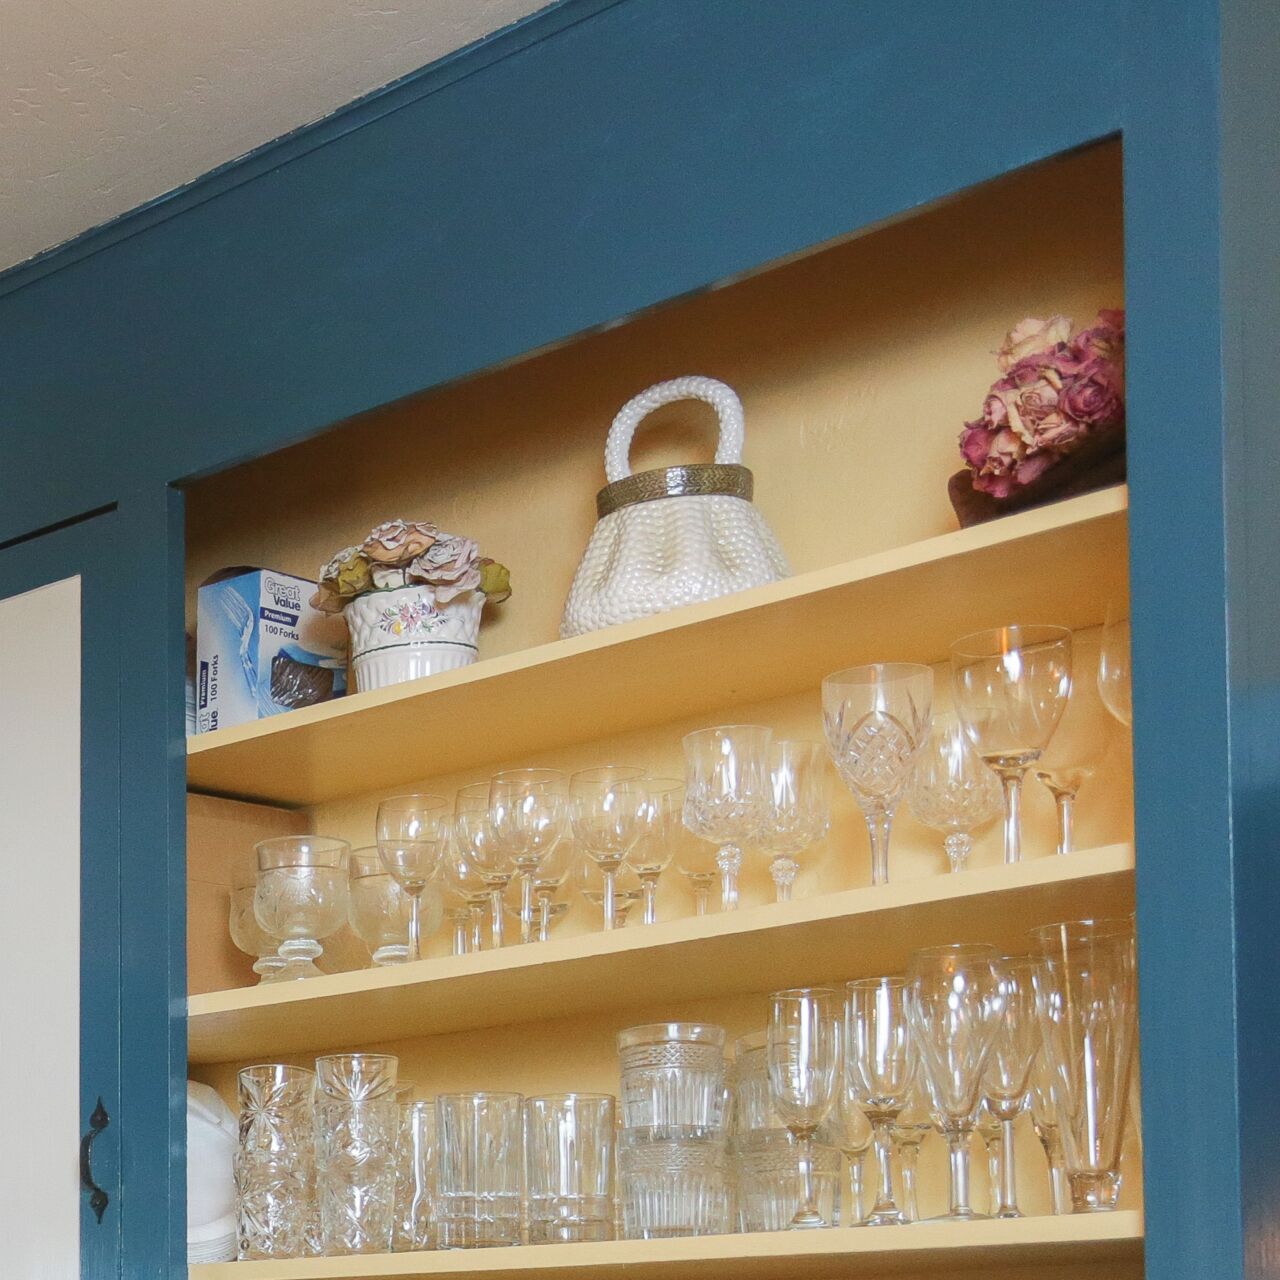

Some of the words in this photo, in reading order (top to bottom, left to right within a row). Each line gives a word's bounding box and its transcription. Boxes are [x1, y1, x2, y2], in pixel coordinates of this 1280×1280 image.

[264, 577, 301, 601] Great
[273, 595, 301, 612] Value
[264, 610, 292, 624] Premium
[265, 624, 278, 636] 100
[279, 629, 300, 641] Forks
[211, 654, 219, 683] Forks
